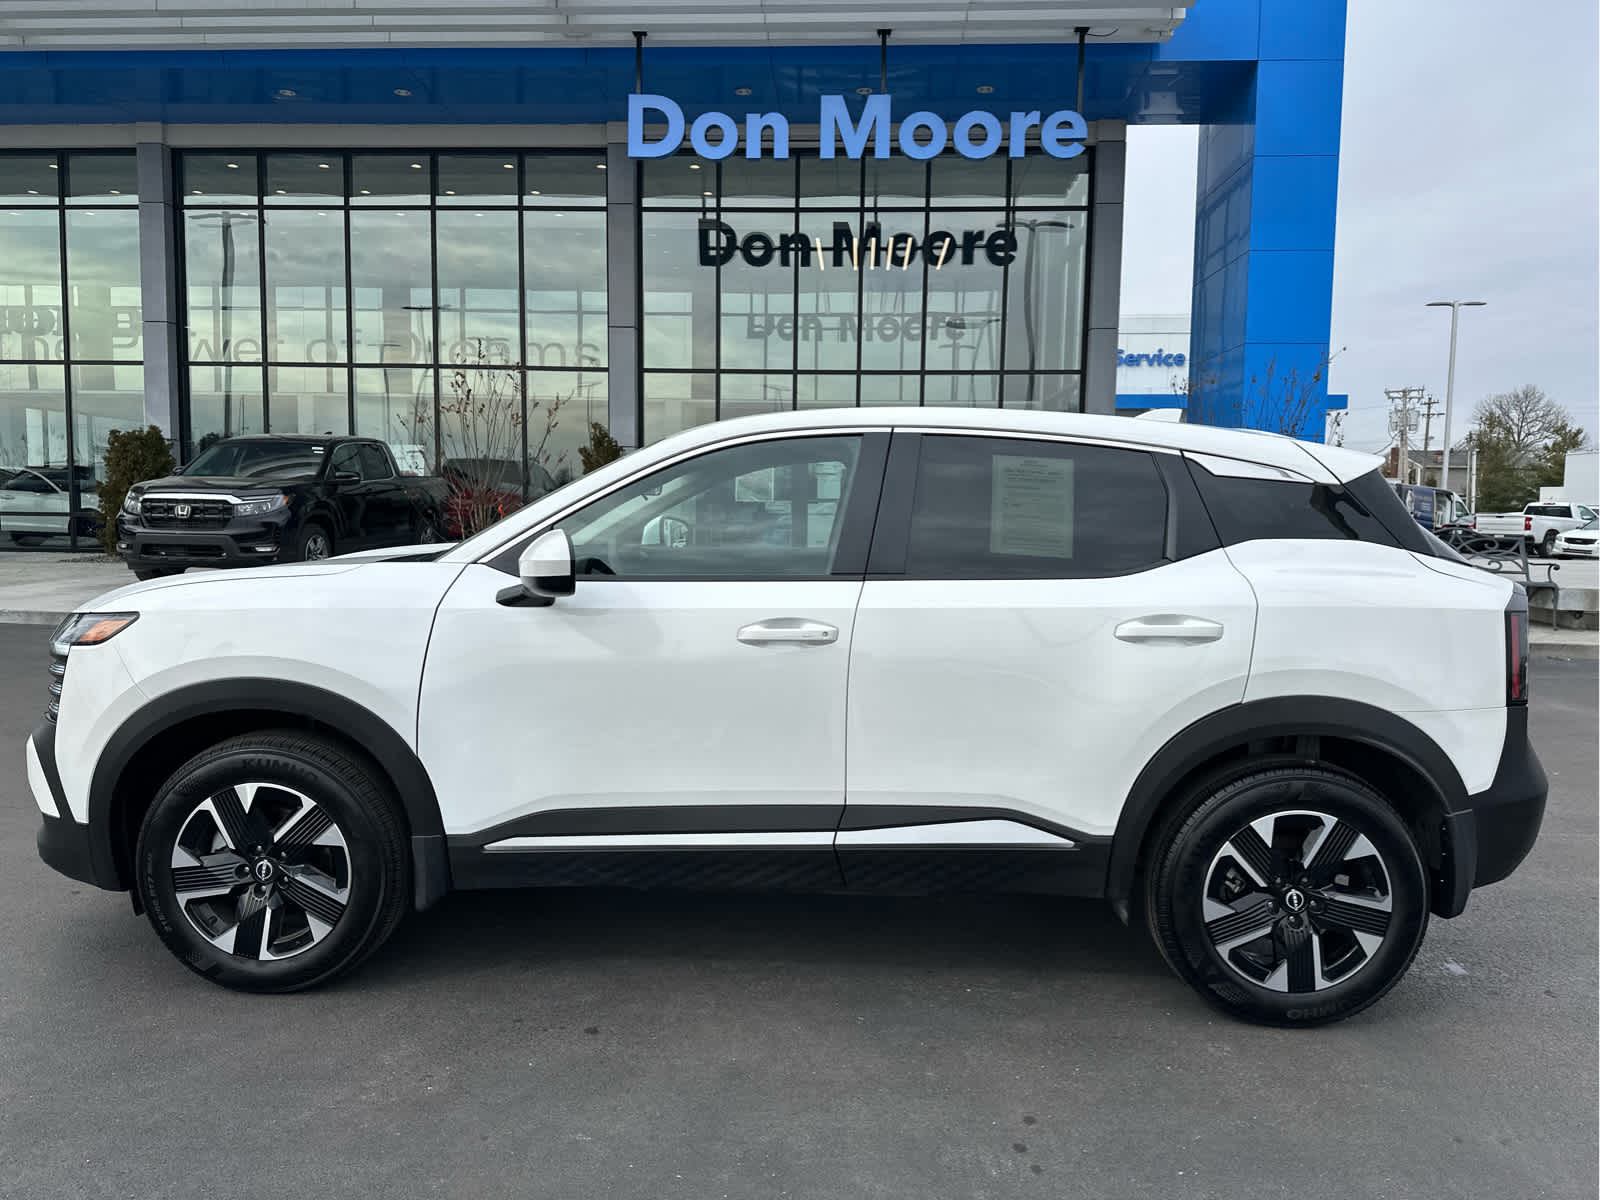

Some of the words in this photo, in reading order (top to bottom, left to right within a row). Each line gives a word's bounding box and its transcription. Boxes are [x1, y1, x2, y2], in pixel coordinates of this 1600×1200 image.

[627, 93, 789, 160] Don
[820, 94, 1088, 160] Moore
[698, 218, 811, 268] Don
[832, 220, 1018, 268] Moore
[1116, 348, 1186, 367] Service
